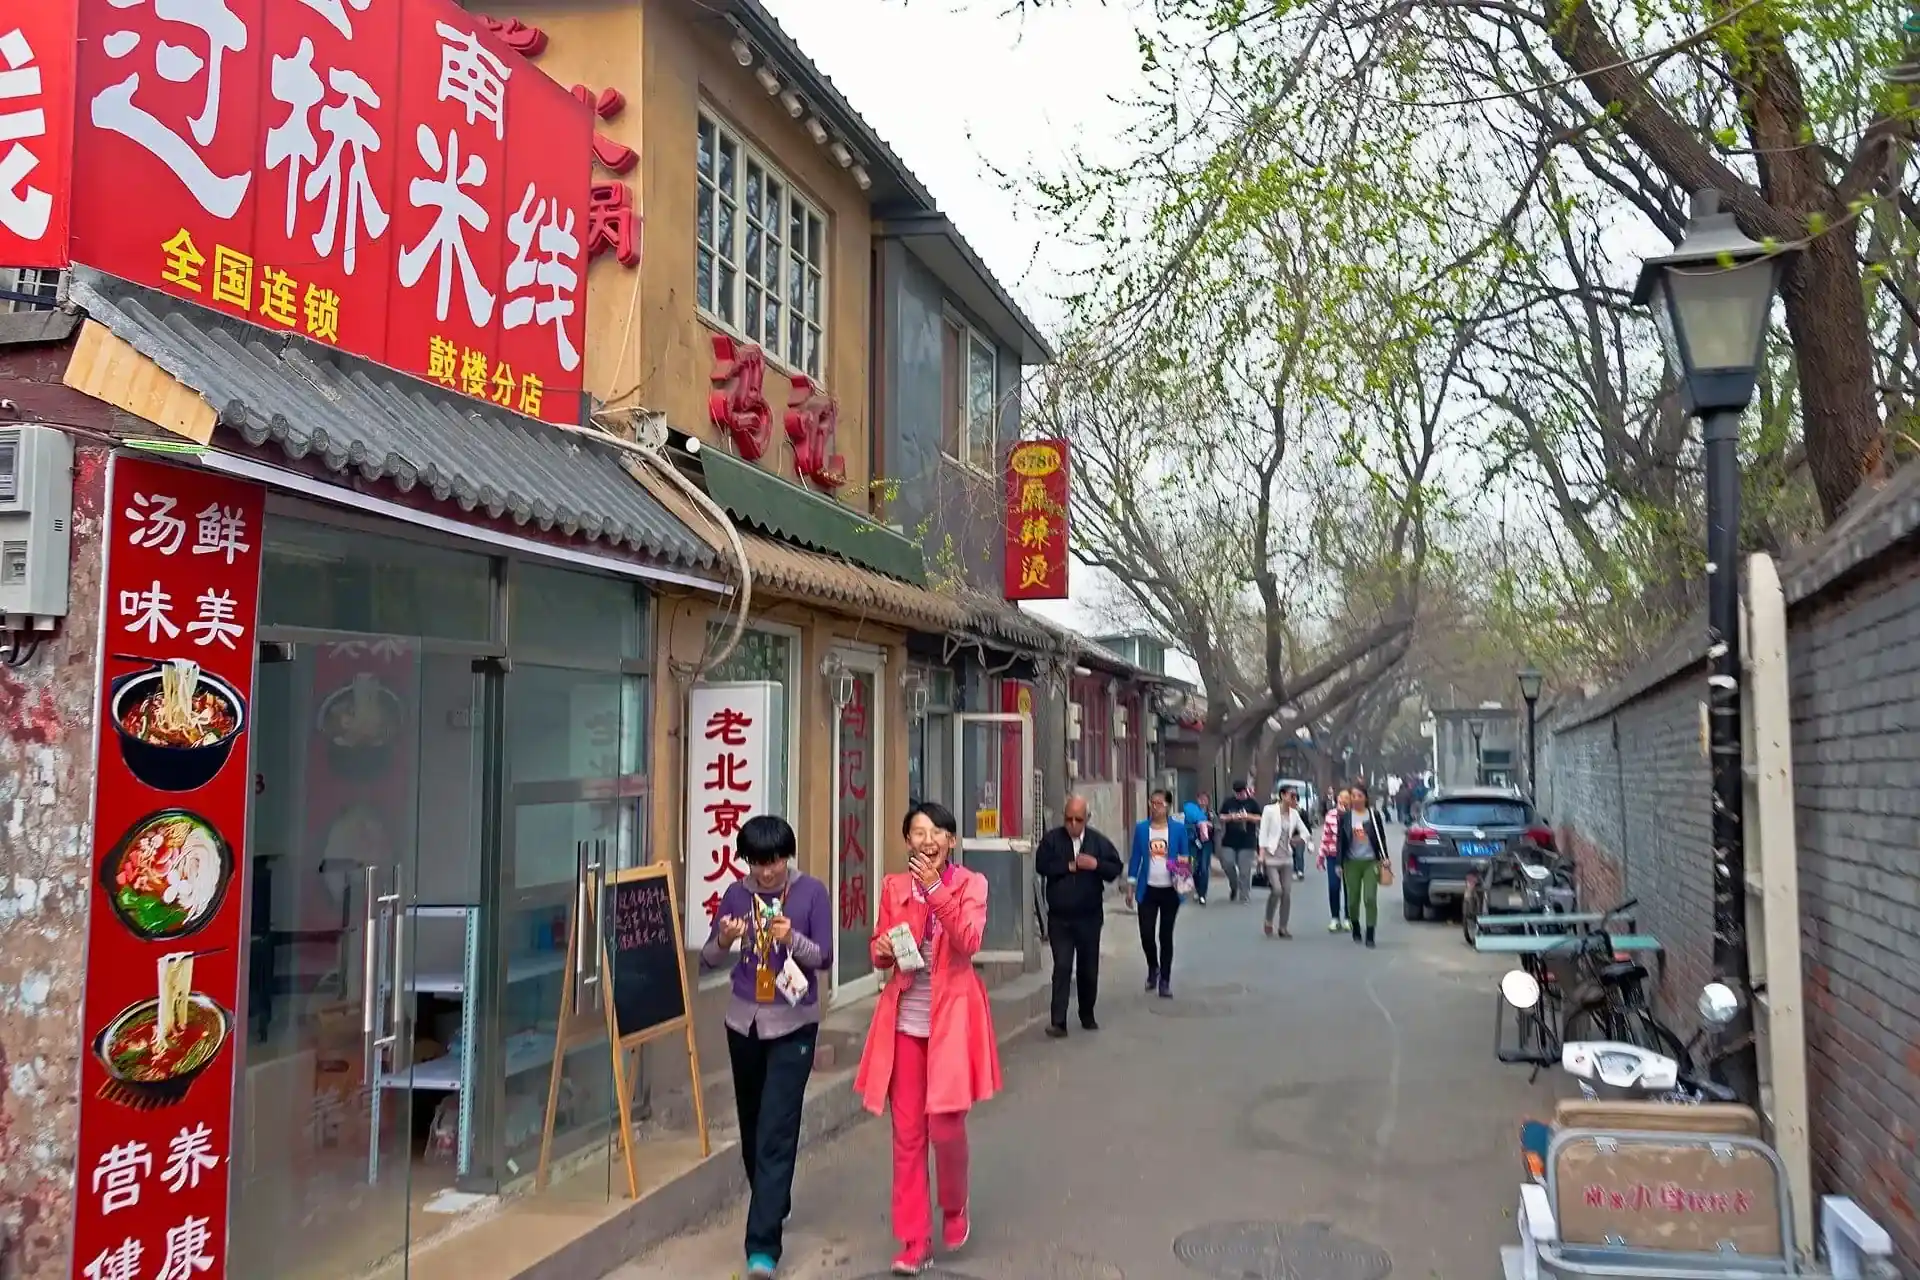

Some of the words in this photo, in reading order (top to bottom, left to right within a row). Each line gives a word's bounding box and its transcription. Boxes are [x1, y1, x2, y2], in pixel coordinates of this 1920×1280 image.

[91, 0, 580, 372] 过桥米线
[161, 227, 341, 344] 全国连锁
[427, 334, 544, 418] 鼓楼分店
[124, 492, 250, 565] 汤鲜
[119, 579, 245, 650] 味美
[702, 707, 753, 928] 老北京火
[91, 1121, 221, 1216] 营养
[83, 1215, 216, 1280] 健康
